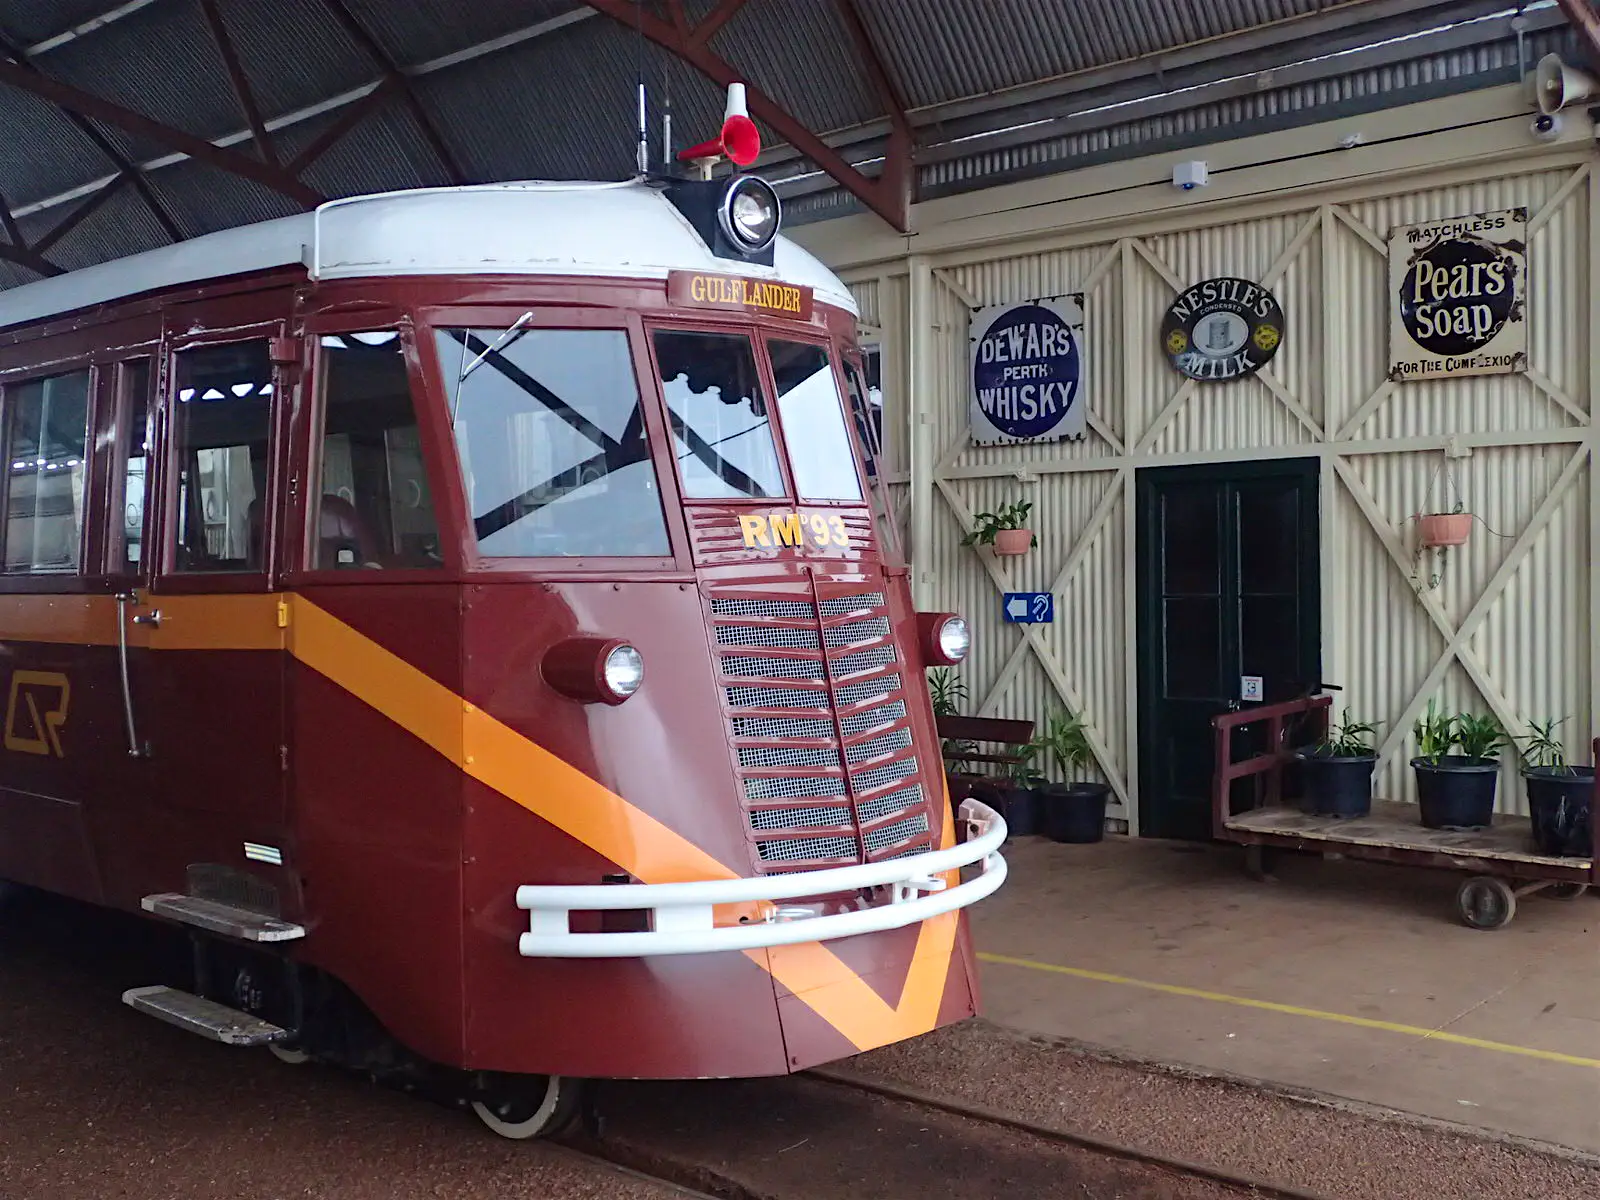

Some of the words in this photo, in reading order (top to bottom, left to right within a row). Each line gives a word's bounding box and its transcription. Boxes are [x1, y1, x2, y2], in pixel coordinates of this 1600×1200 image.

[1406, 217, 1506, 244] MATCHLESS
[1199, 302, 1243, 316] CONDENSED
[1415, 303, 1494, 341] Soap
[981, 322, 1071, 364] DEWAR'S
[1003, 363, 1048, 381] PERTH
[1183, 348, 1257, 379] MILK
[979, 381, 1073, 421] WHISKY
